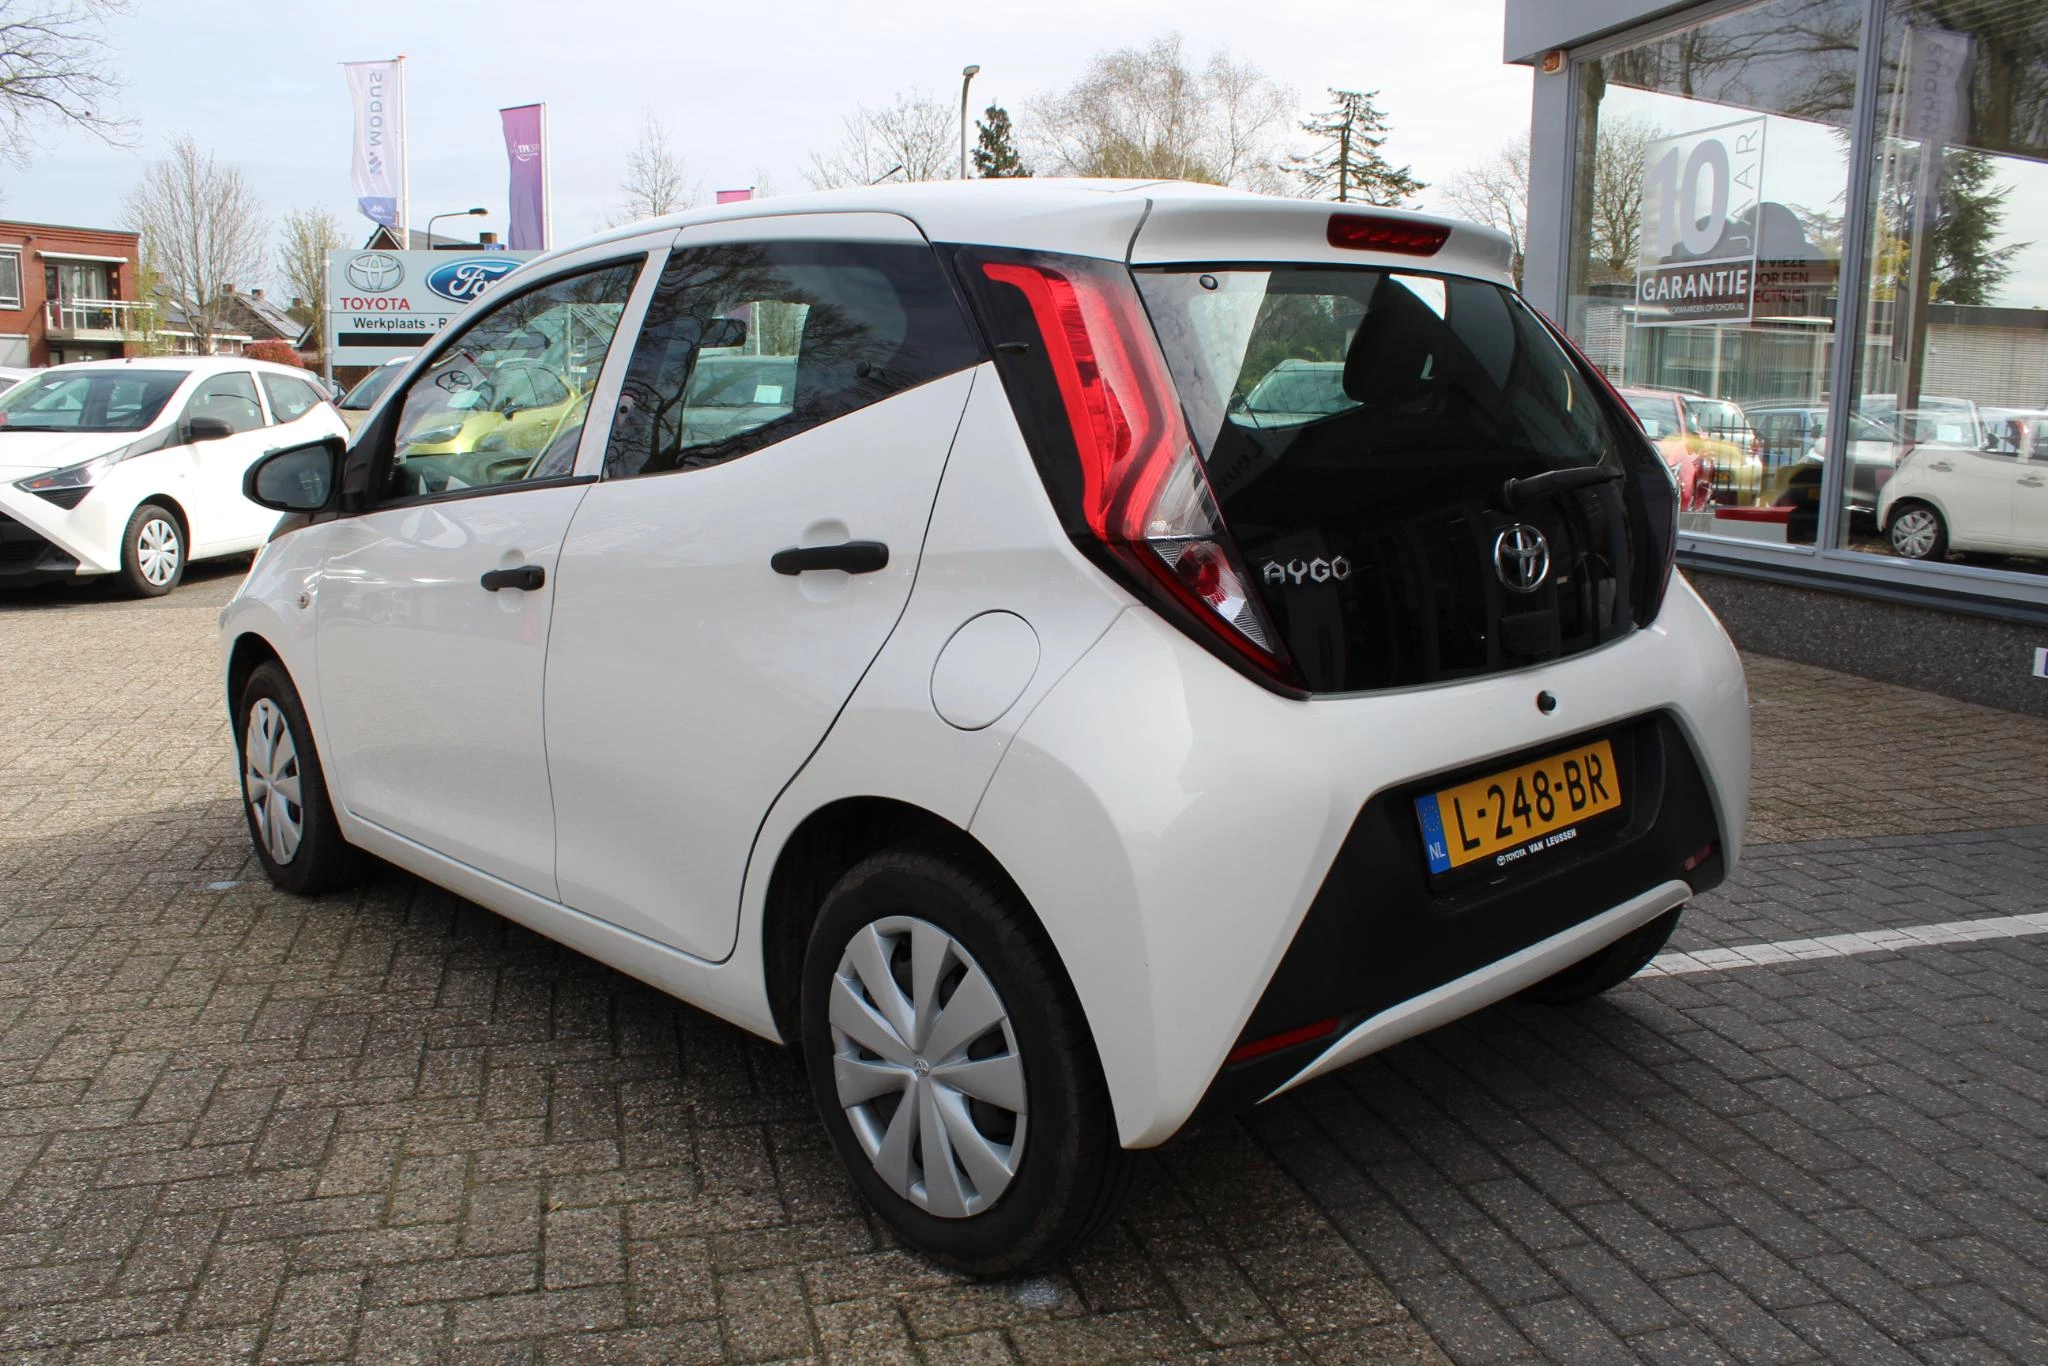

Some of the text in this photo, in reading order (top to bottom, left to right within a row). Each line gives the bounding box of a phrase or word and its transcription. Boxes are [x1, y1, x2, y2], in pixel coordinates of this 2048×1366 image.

[1650, 138, 1730, 258] 10
[449, 264, 508, 296] Fo
[1641, 269, 1748, 301] GARANTIE
[340, 298, 410, 310] TOYOTA
[354, 318, 425, 331] Werkplaats
[438, 318, 447, 329] R
[1263, 554, 1351, 585] AYGO
[1453, 752, 1609, 852] L-248-BR
[1428, 842, 1446, 861] NL
[1505, 827, 1577, 862] TOYOTA VAN LEUSSEN
